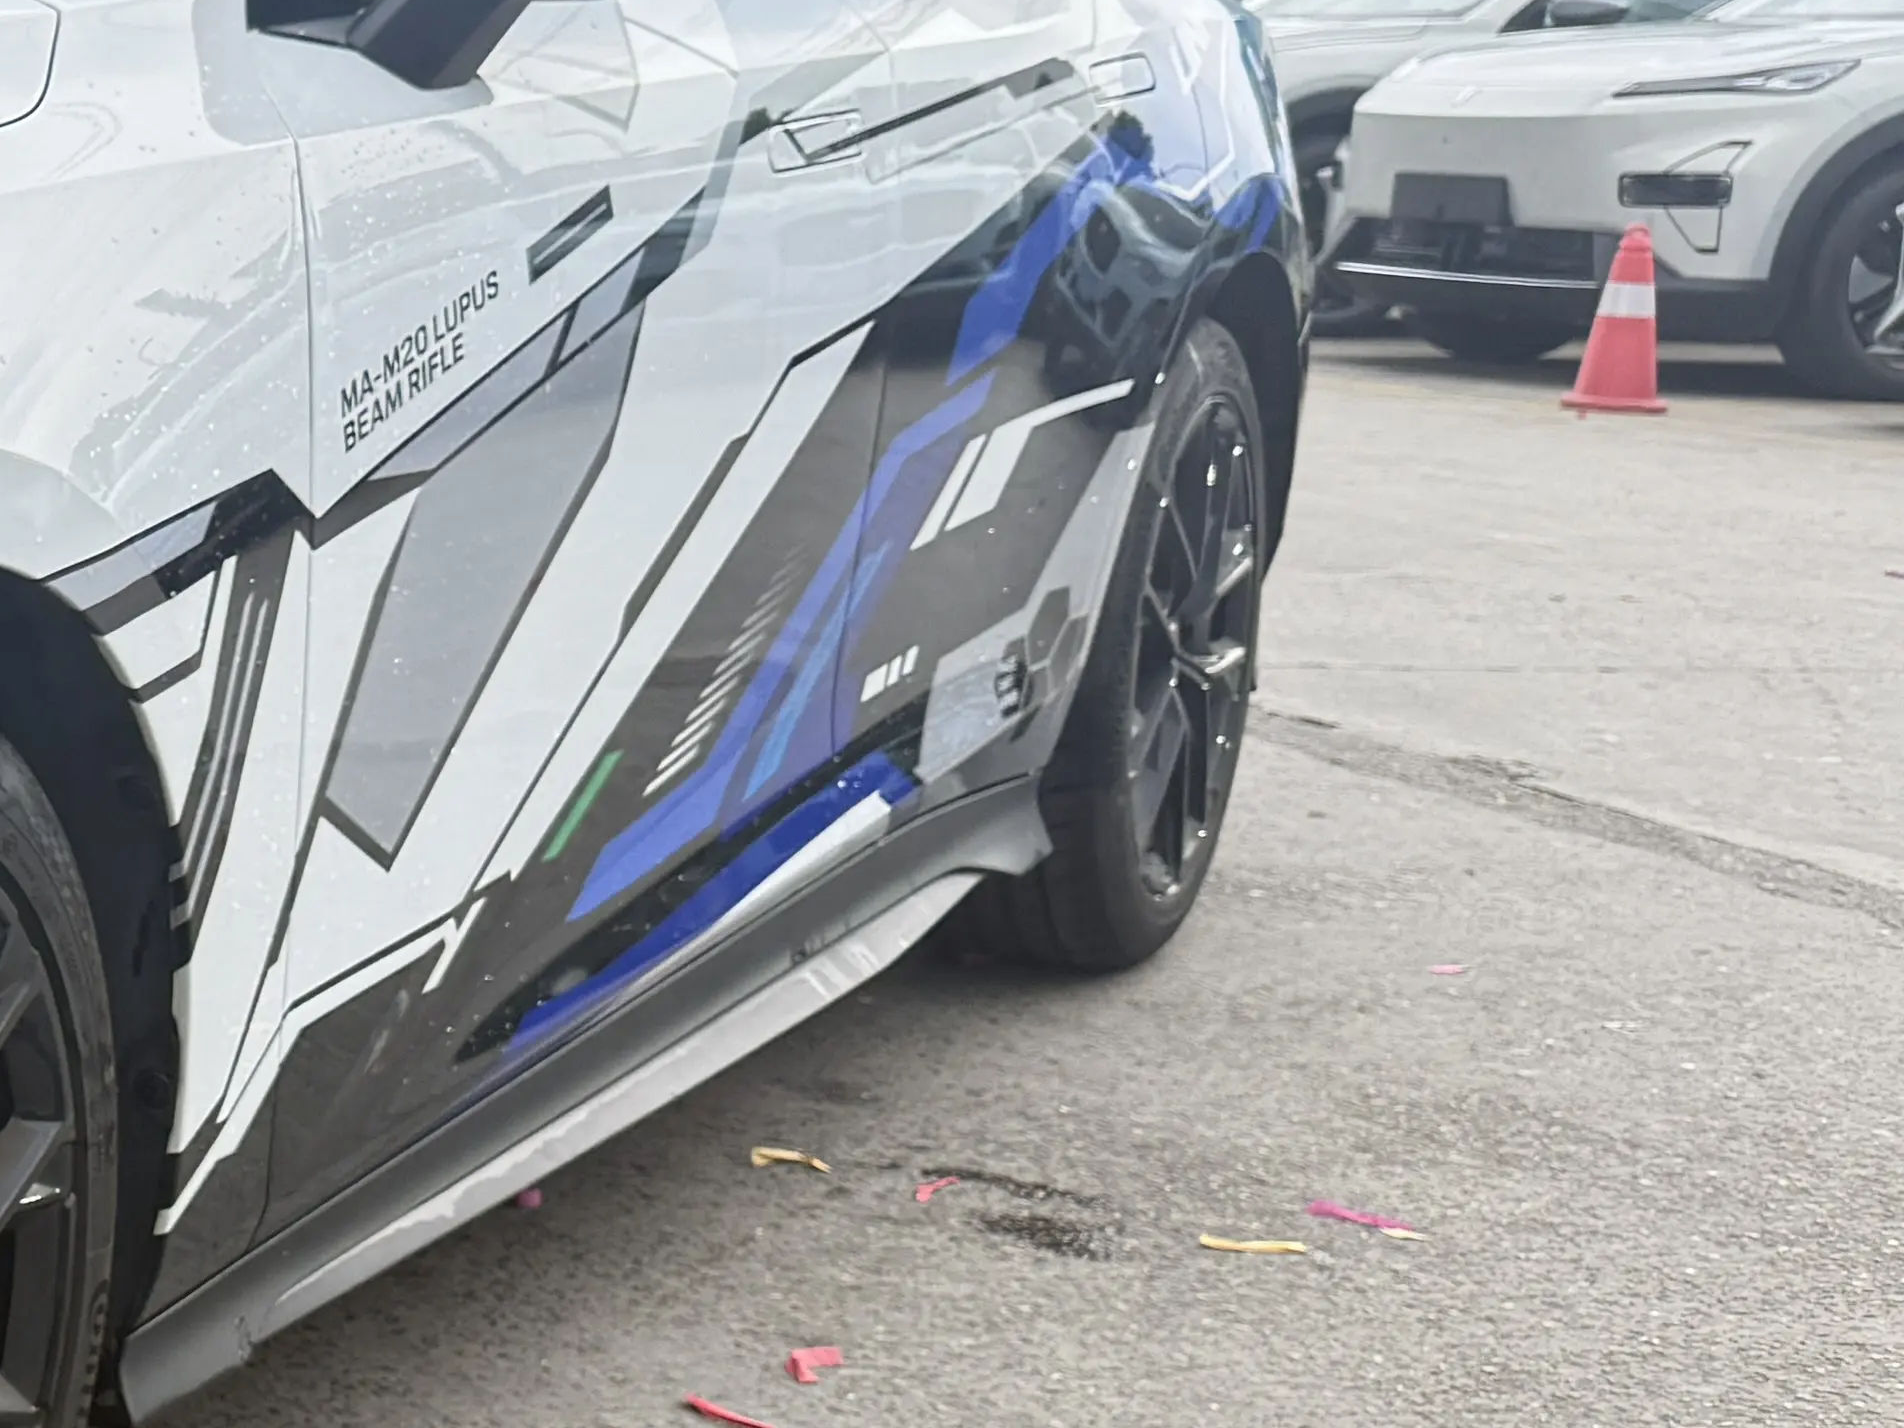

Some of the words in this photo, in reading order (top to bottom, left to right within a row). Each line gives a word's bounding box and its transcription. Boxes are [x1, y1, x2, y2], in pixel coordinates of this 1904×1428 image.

[341, 324, 428, 418] MA-M20
[432, 270, 499, 344] LUPUS
[343, 379, 404, 453] BEAM
[408, 332, 465, 399] RIFLE
